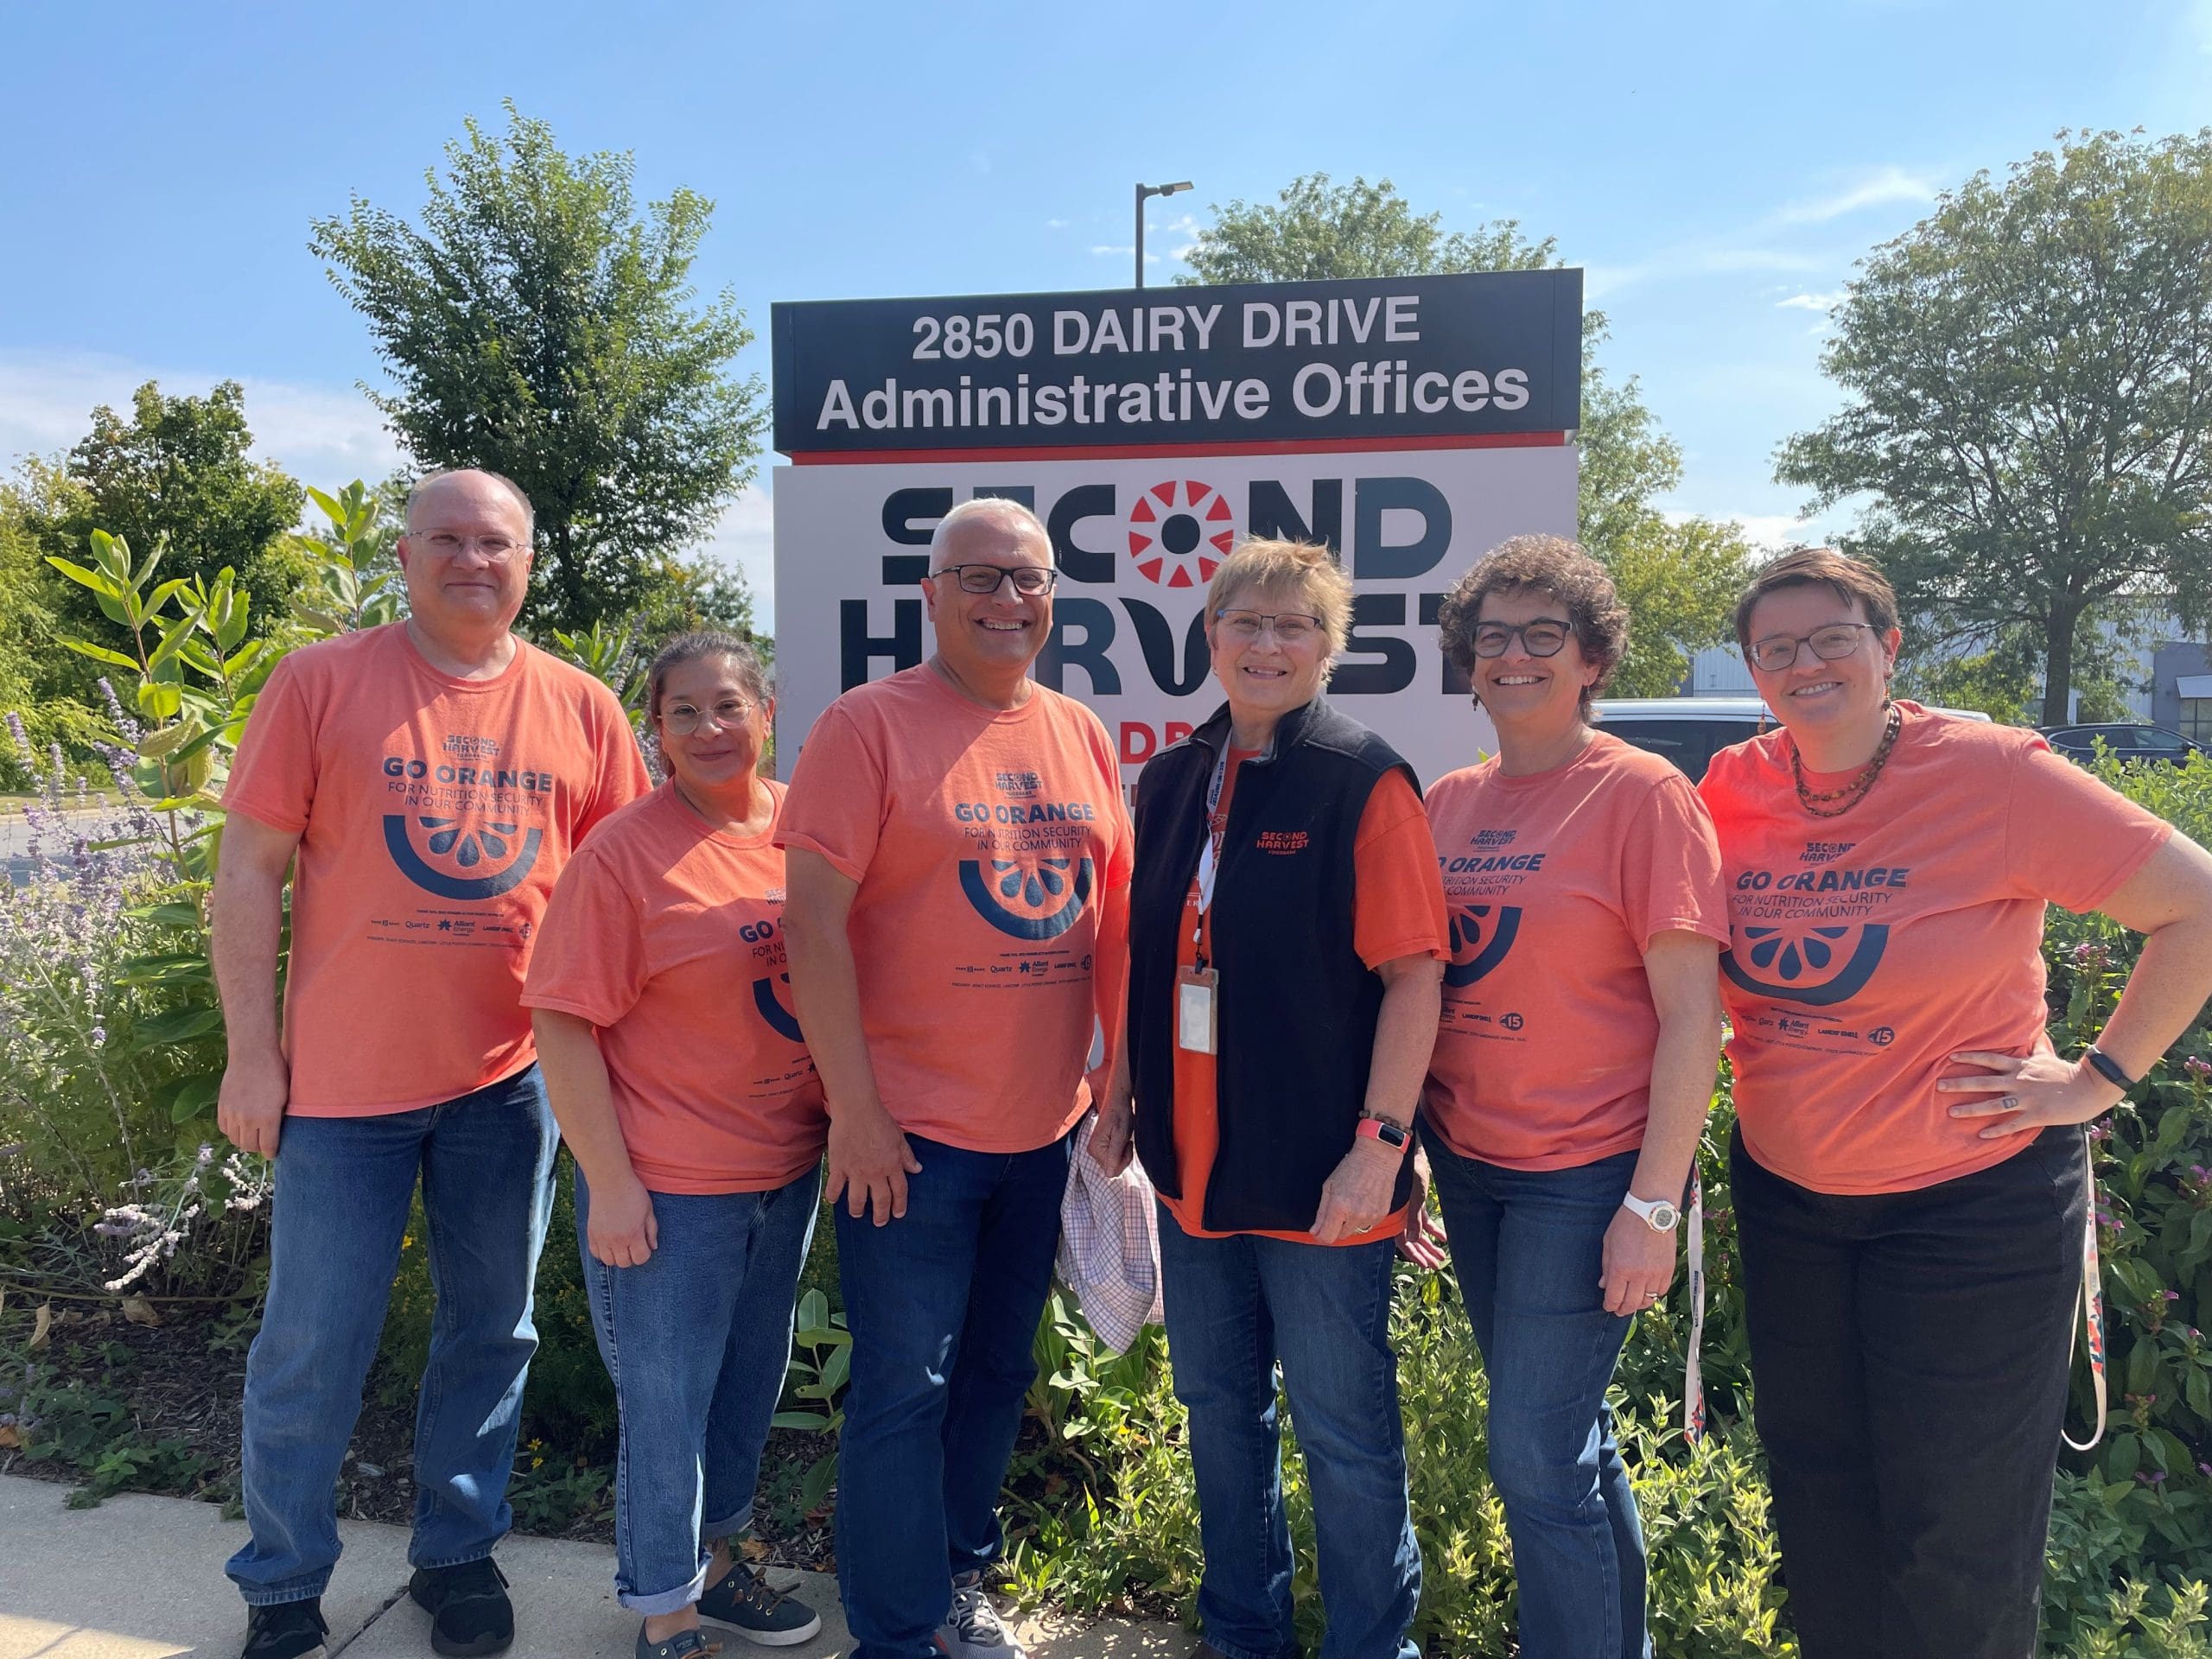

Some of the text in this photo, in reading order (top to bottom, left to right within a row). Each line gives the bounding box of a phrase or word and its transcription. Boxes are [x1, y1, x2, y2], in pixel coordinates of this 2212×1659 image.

[912, 296, 1420, 359] 2850 DAIRY DRIVE
[817, 360, 1529, 430] Administrative Offices
[882, 477, 1452, 585] SCOND
[448, 734, 496, 747] SECOND
[442, 742, 499, 756] HARVEST
[384, 757, 553, 793] GO ORANGE
[996, 772, 1038, 781] SECOND
[995, 781, 1042, 791] HARVEST
[389, 782, 543, 806] FOR NUTRITION SECURITY
[405, 796, 531, 815] IN OUR COMMUNITY
[955, 802, 1095, 824] GO ORANGE
[965, 826, 1091, 840] FOR NUTRITION SECURITY
[1262, 831, 1307, 841] SECOND
[1478, 830, 1516, 838] SECOND
[978, 838, 1081, 851] IN OUR COMMUNITY
[1256, 839, 1309, 849] HARVEST
[1470, 836, 1516, 845] HARVEST
[1449, 854, 1546, 873] ORANGE
[1443, 874, 1527, 885] TRITION SECURITY
[1737, 868, 1910, 892] GO ORANGE
[1446, 886, 1510, 895] COMMUNITY
[1732, 892, 1893, 907] FOR NUTRITION SECURITY
[1737, 906, 1873, 918] IN OUR COMMUNITY
[740, 920, 774, 943] GO
[753, 944, 772, 958] FOR
[766, 956, 777, 967] IN
[1508, 1016, 1521, 1027] 15
[1877, 1030, 1891, 1042] 15
